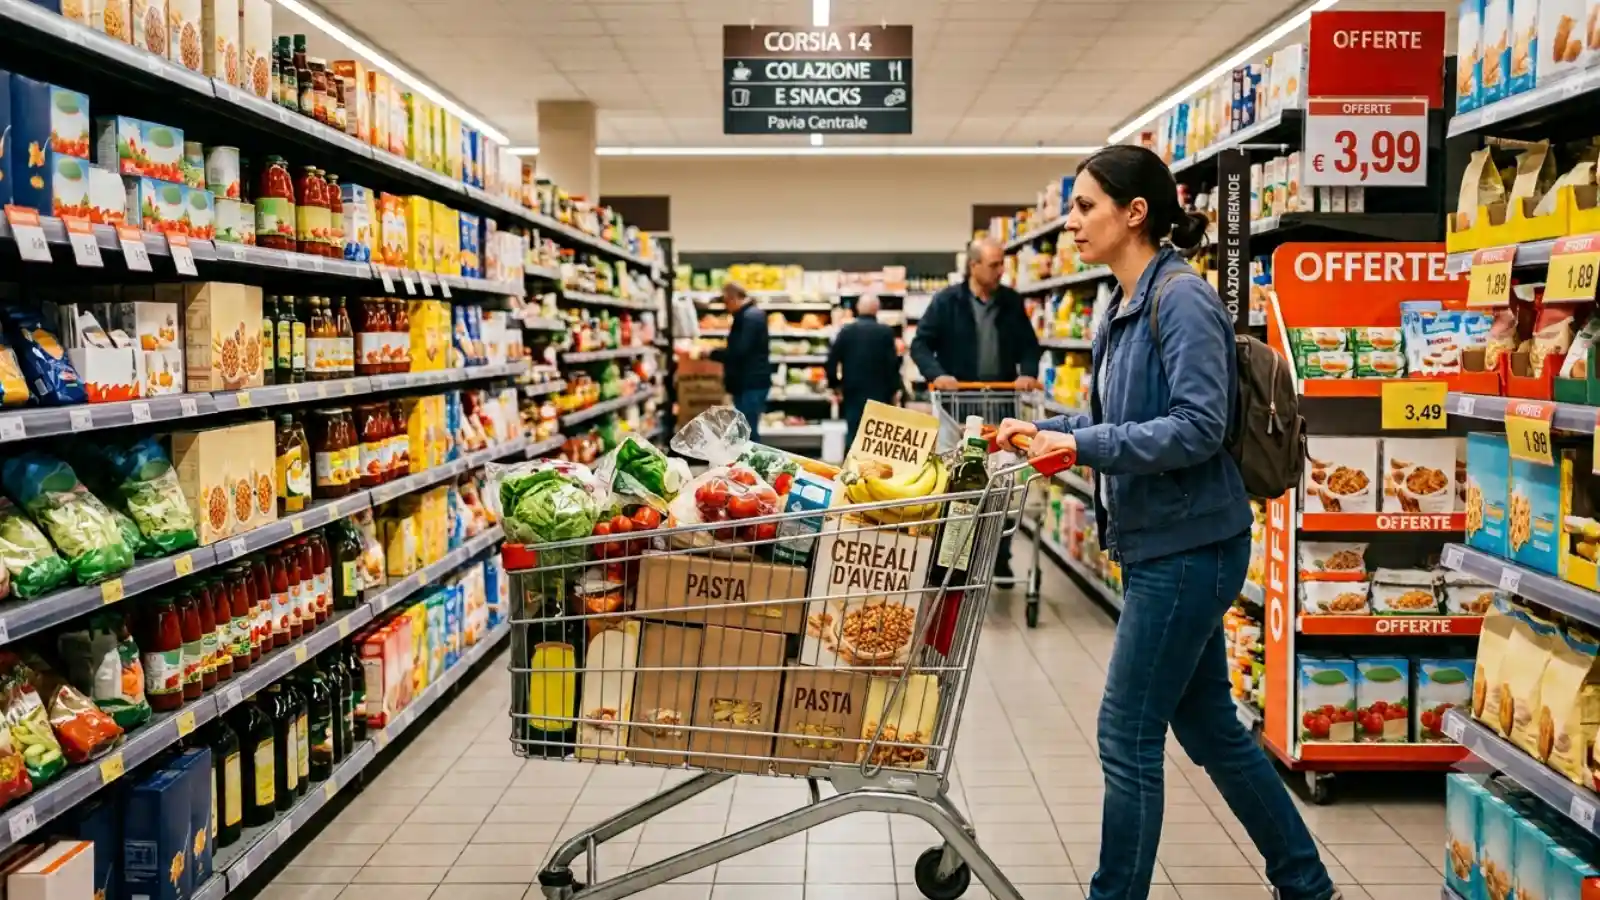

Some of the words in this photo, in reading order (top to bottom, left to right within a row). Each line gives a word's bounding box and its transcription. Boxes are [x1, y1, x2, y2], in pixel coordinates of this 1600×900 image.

[764, 32, 841, 51] CORSIA
[848, 32, 872, 51] 14
[1333, 30, 1422, 49] OFFERTE
[765, 62, 871, 79] COLAZIONE
[775, 88, 785, 105] E
[790, 88, 861, 105] SNACKS
[1342, 103, 1391, 114] OFFERTE
[768, 115, 805, 129] Pavia
[808, 115, 867, 129] Centrale
[1313, 154, 1325, 173] €
[1334, 130, 1421, 181] 3,99
[864, 418, 928, 449] CEREALI
[861, 437, 918, 465] D'AVENA
[1376, 515, 1452, 530] OFFERTE
[831, 539, 917, 572] CEREALI
[833, 565, 909, 592] D'AVENA
[687, 573, 746, 604] PASTA
[1376, 619, 1452, 633] OFFERTE
[794, 687, 852, 715] PASTA
